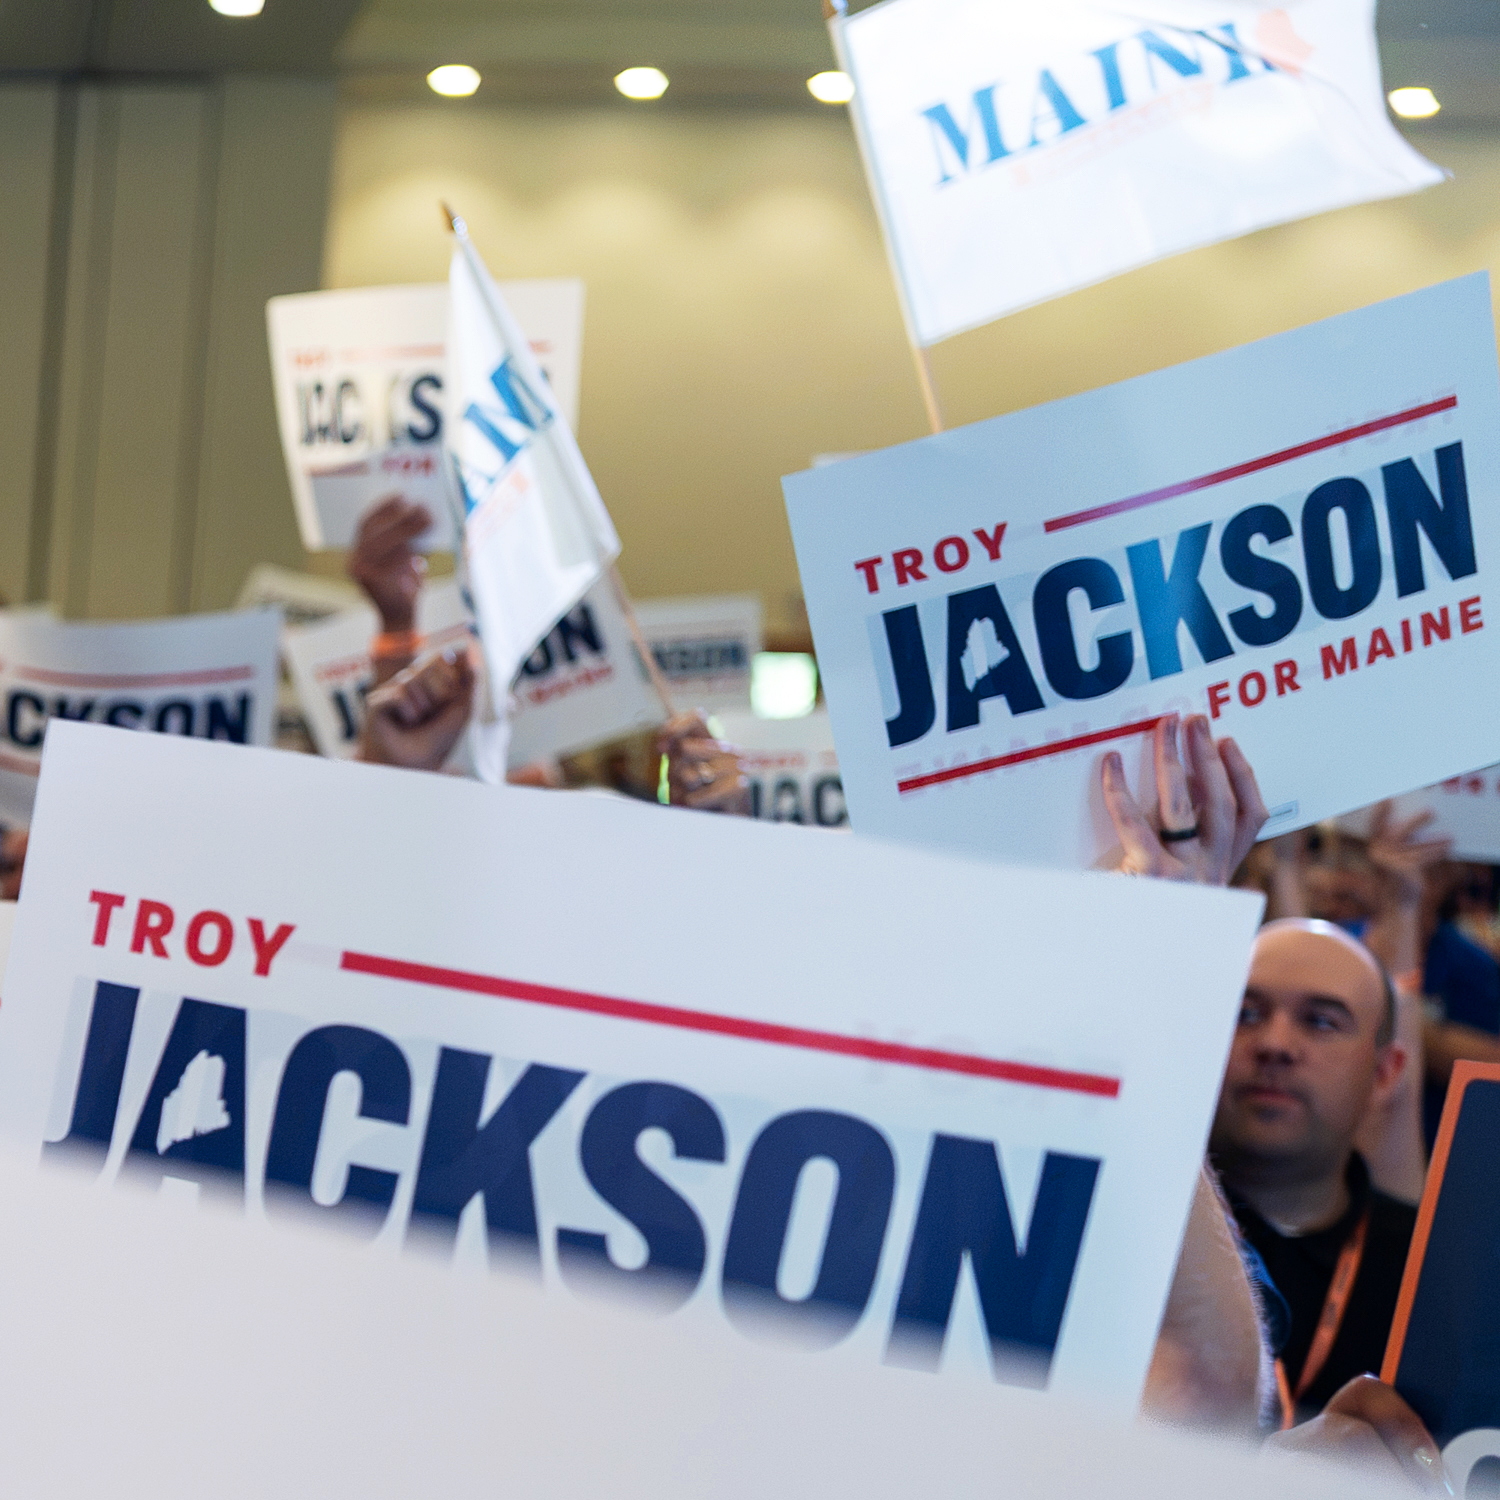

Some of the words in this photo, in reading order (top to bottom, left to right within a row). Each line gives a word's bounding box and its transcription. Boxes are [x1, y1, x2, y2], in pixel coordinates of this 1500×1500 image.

[855, 522, 1009, 595] TROY
[883, 439, 1479, 751] JACKSON
[1206, 659, 1302, 721] FOR
[1319, 595, 1486, 681] MAINE
[88, 890, 297, 977] TROY
[40, 979, 1102, 1391] JACKSON
